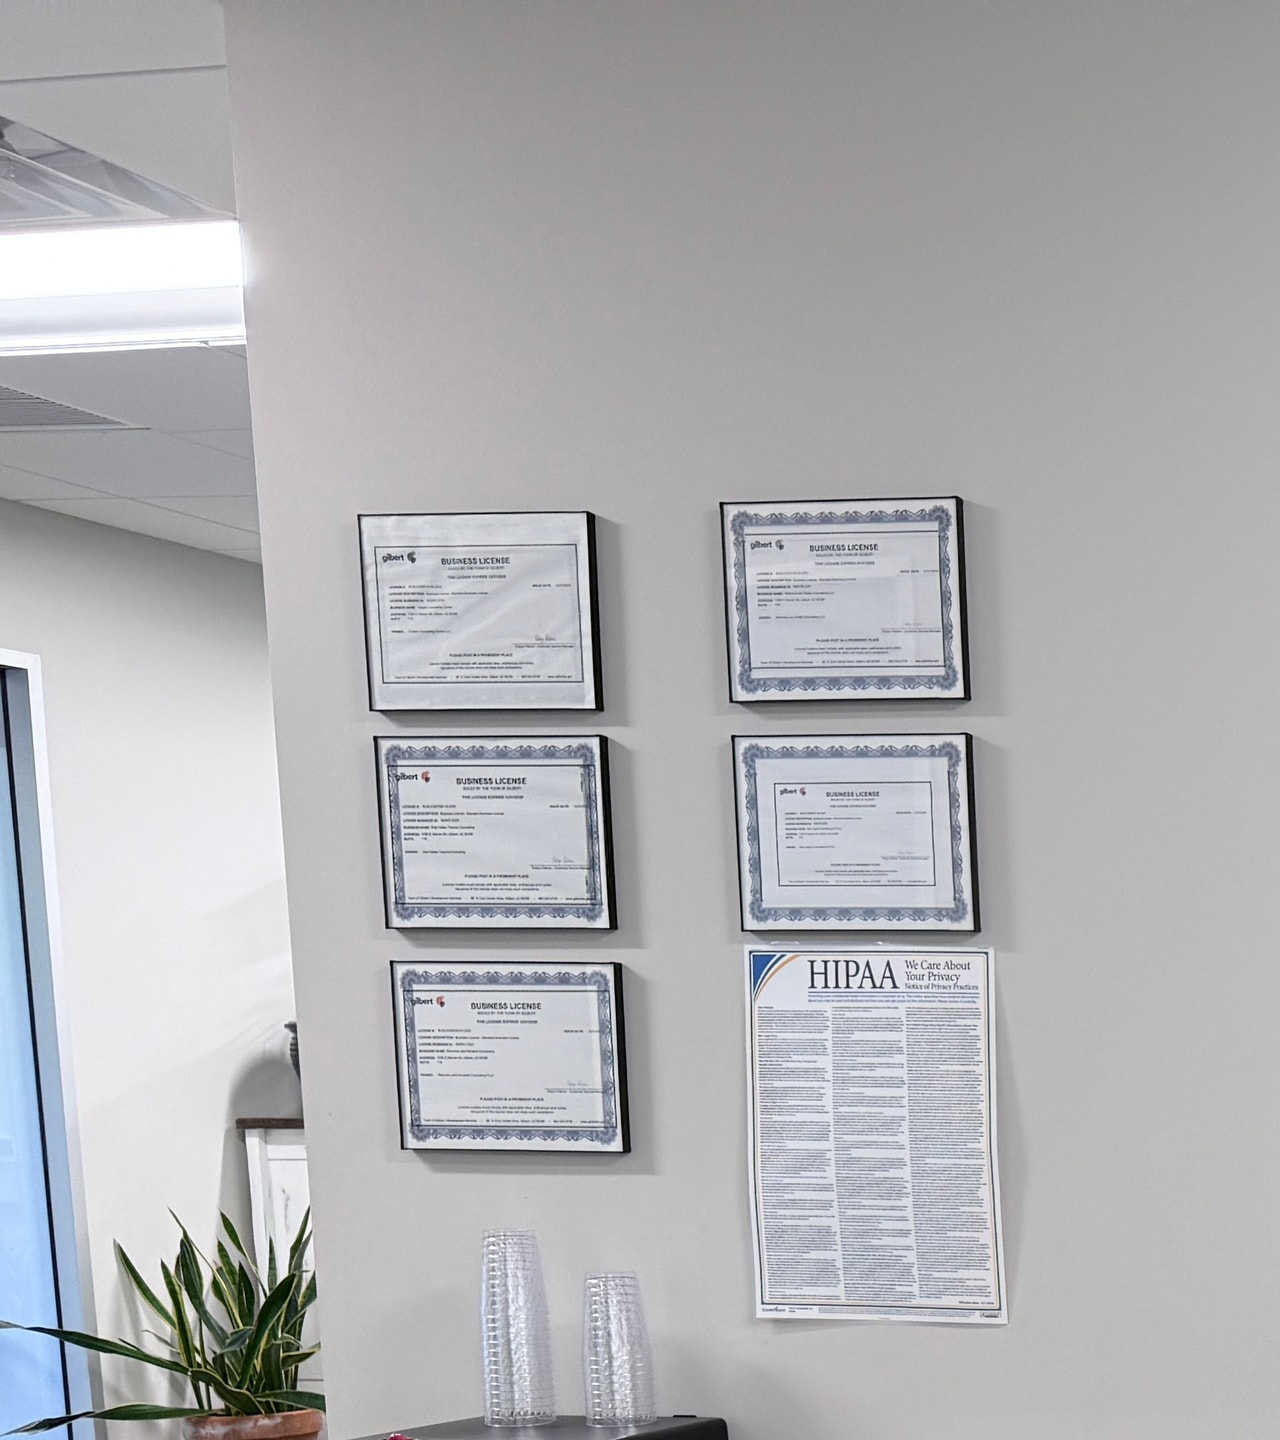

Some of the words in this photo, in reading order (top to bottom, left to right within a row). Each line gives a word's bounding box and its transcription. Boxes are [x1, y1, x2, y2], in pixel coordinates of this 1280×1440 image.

[750, 540, 773, 550] gilbert
[809, 543, 846, 552] BUSINESS
[847, 543, 879, 551] LICENSE
[382, 553, 405, 563] gilbert
[440, 557, 477, 566] BUSINESS
[479, 556, 511, 565] LICENSE
[456, 777, 494, 785] BUSINESS
[495, 777, 527, 785] LICENSE
[905, 960, 919, 970] We
[920, 960, 941, 971] Care
[943, 961, 971, 971] About
[808, 959, 900, 990] HIPAA
[905, 971, 925, 981] Your
[927, 972, 961, 984] Privacy
[923, 982, 931, 990] of
[931, 983, 952, 992] Privacy
[953, 983, 979, 991] Practices
[470, 1002, 508, 1010] BUSINESS
[510, 1002, 542, 1010] LICENSE
